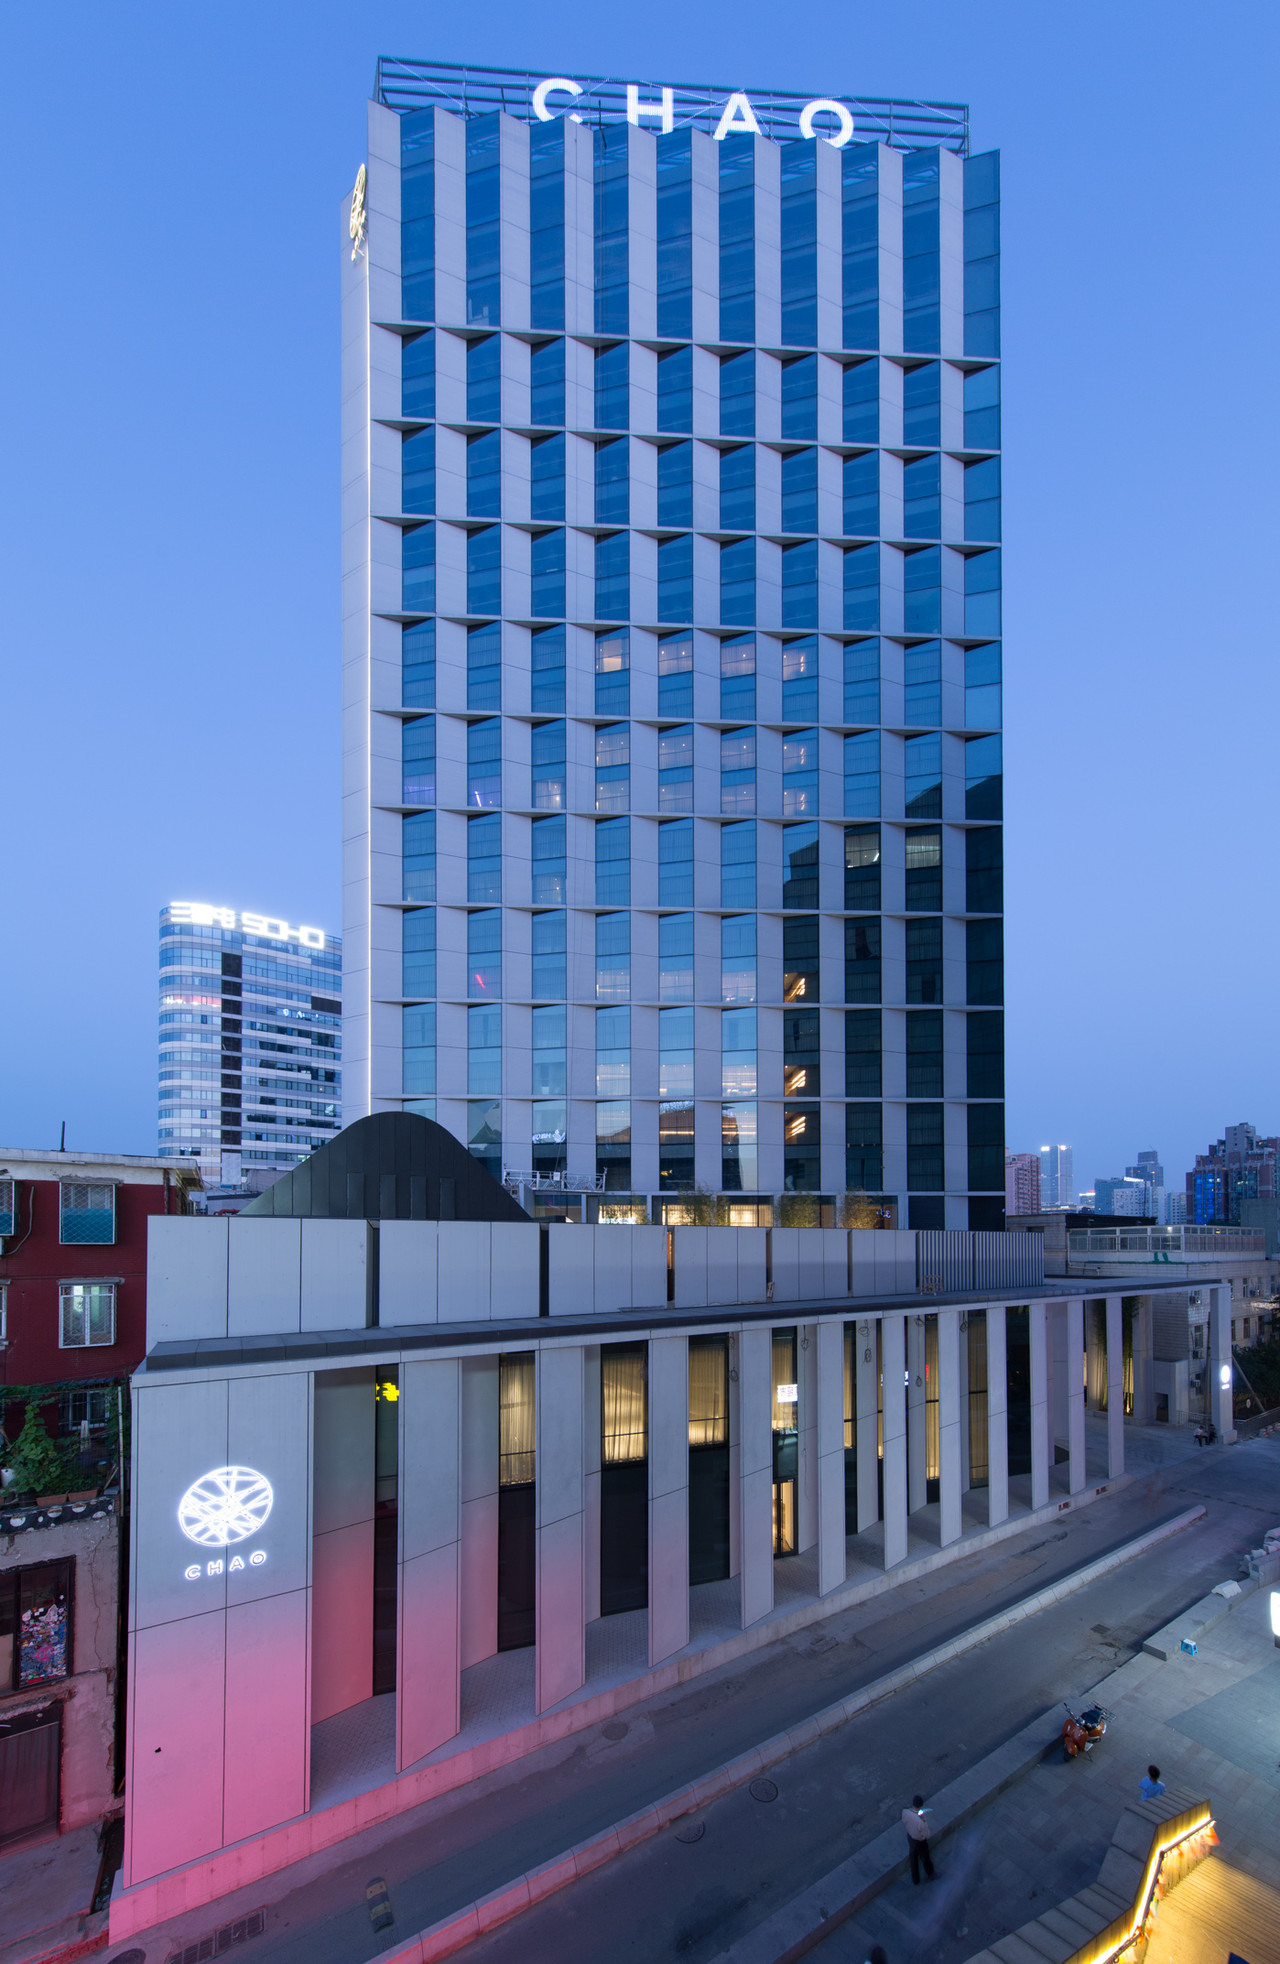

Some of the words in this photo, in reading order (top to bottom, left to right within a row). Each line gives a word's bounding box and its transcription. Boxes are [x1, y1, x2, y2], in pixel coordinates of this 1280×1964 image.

[533, 78, 854, 148] CHAO
[241, 911, 325, 950] SOHO
[184, 1550, 267, 1580] CHAO
